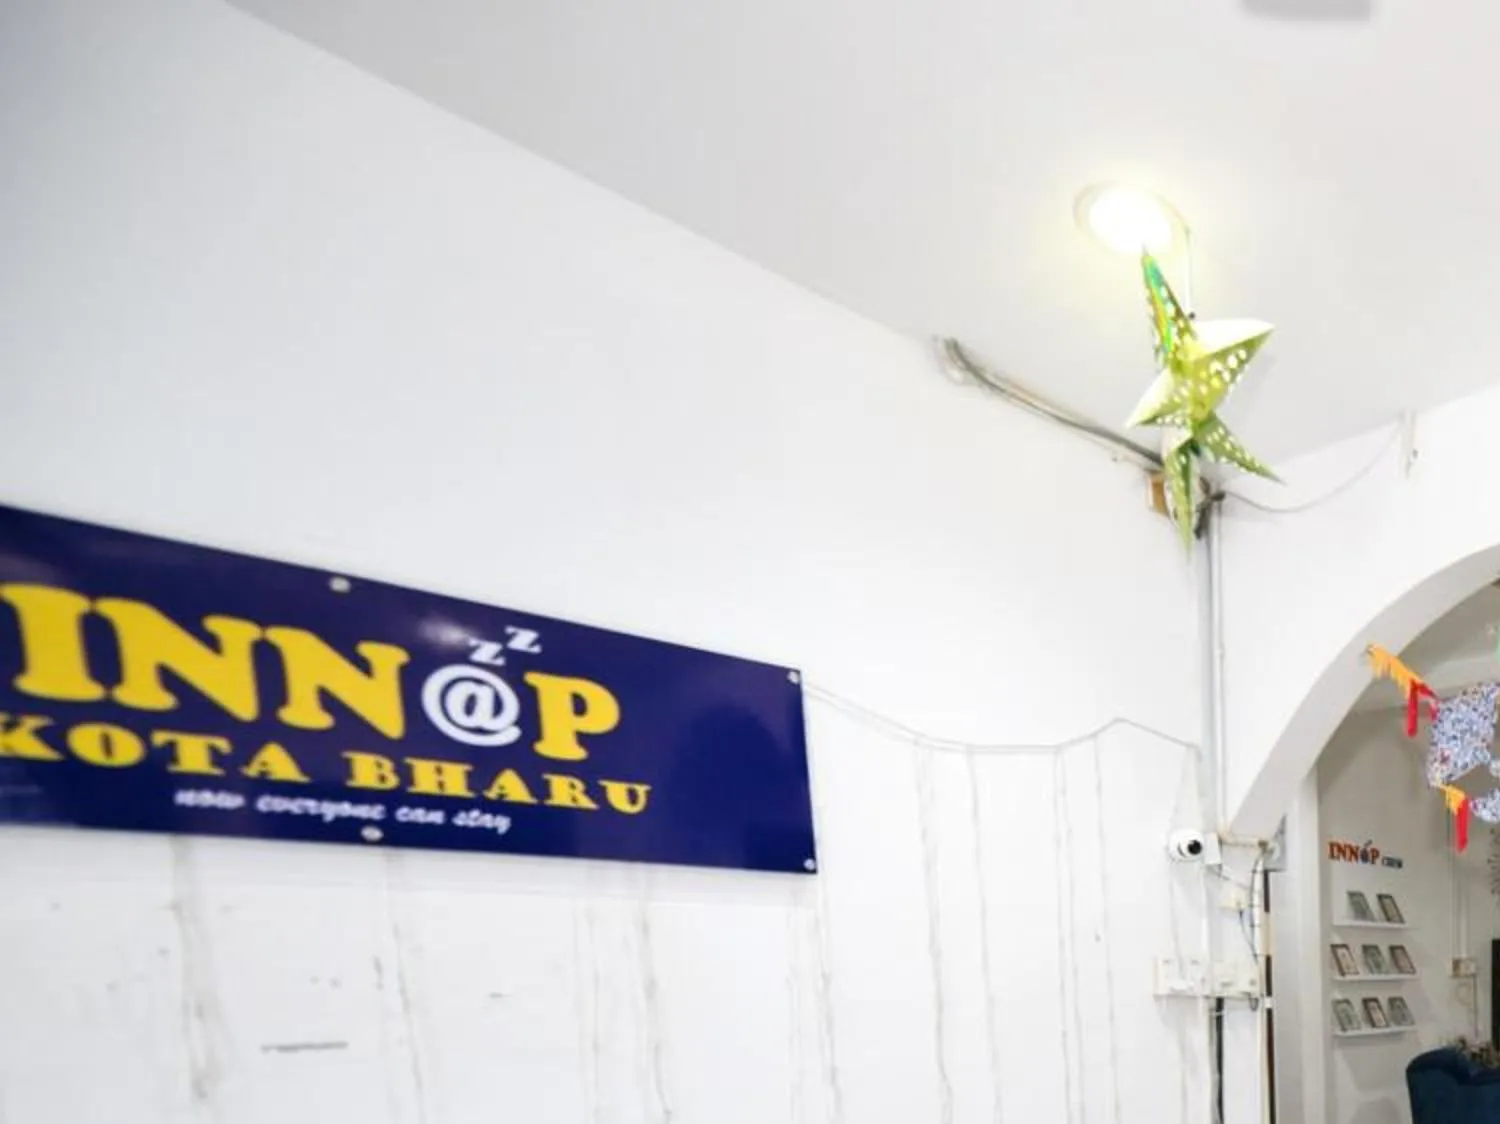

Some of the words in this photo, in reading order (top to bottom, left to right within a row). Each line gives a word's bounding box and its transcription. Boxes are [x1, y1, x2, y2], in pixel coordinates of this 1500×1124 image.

[0, 711, 310, 783] KOTA
[343, 751, 651, 814] BHARU
[255, 794, 387, 823] everyone
[395, 806, 446, 825] can
[452, 808, 512, 836] stay
